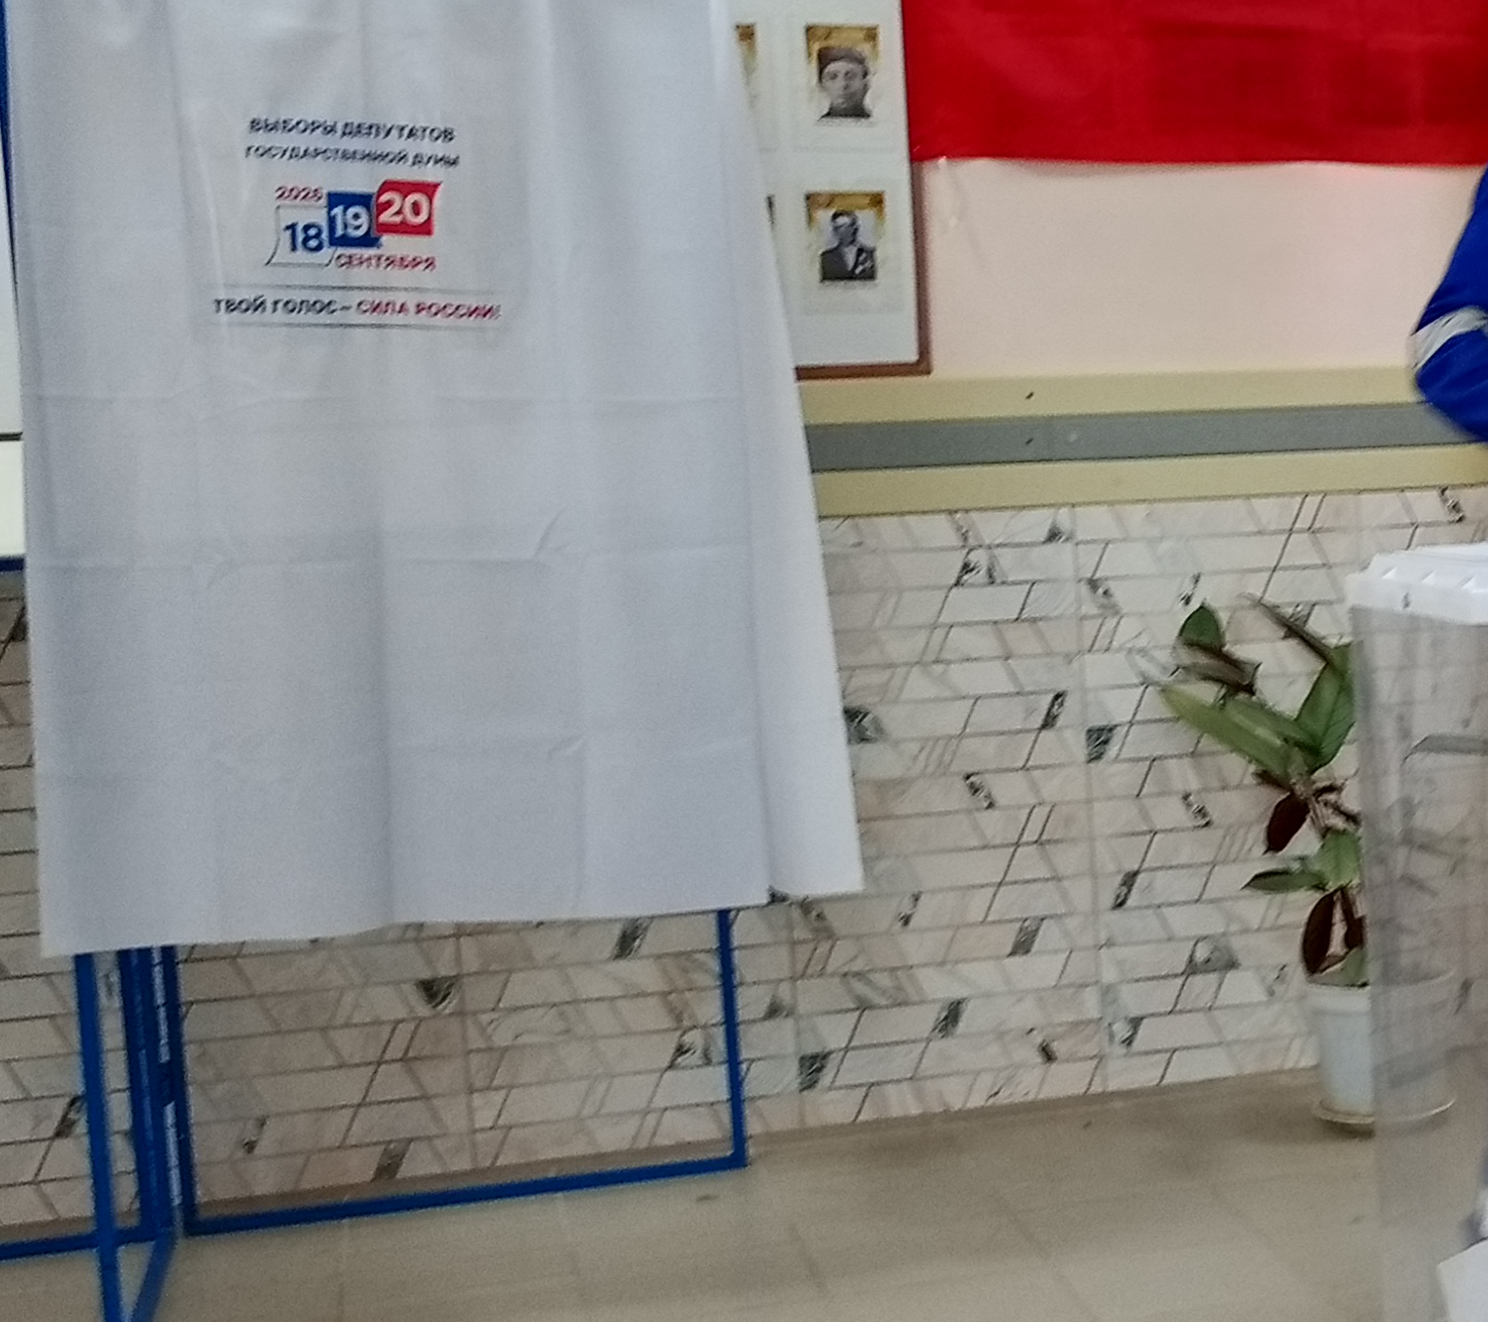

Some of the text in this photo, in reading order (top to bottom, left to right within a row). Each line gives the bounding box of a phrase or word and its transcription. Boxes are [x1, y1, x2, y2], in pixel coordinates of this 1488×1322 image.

[249, 117, 456, 144] ВЫБОРЫ ДЕПУТАТОВ
[245, 144, 460, 169] ГОСУДАРСТВЕННОЙ ДУМЫ
[283, 190, 431, 253] 18 19 20
[334, 253, 437, 272] СЕНТЯБРЯ
[213, 293, 267, 315] ТВОЙ
[356, 299, 409, 316] СИЛА
